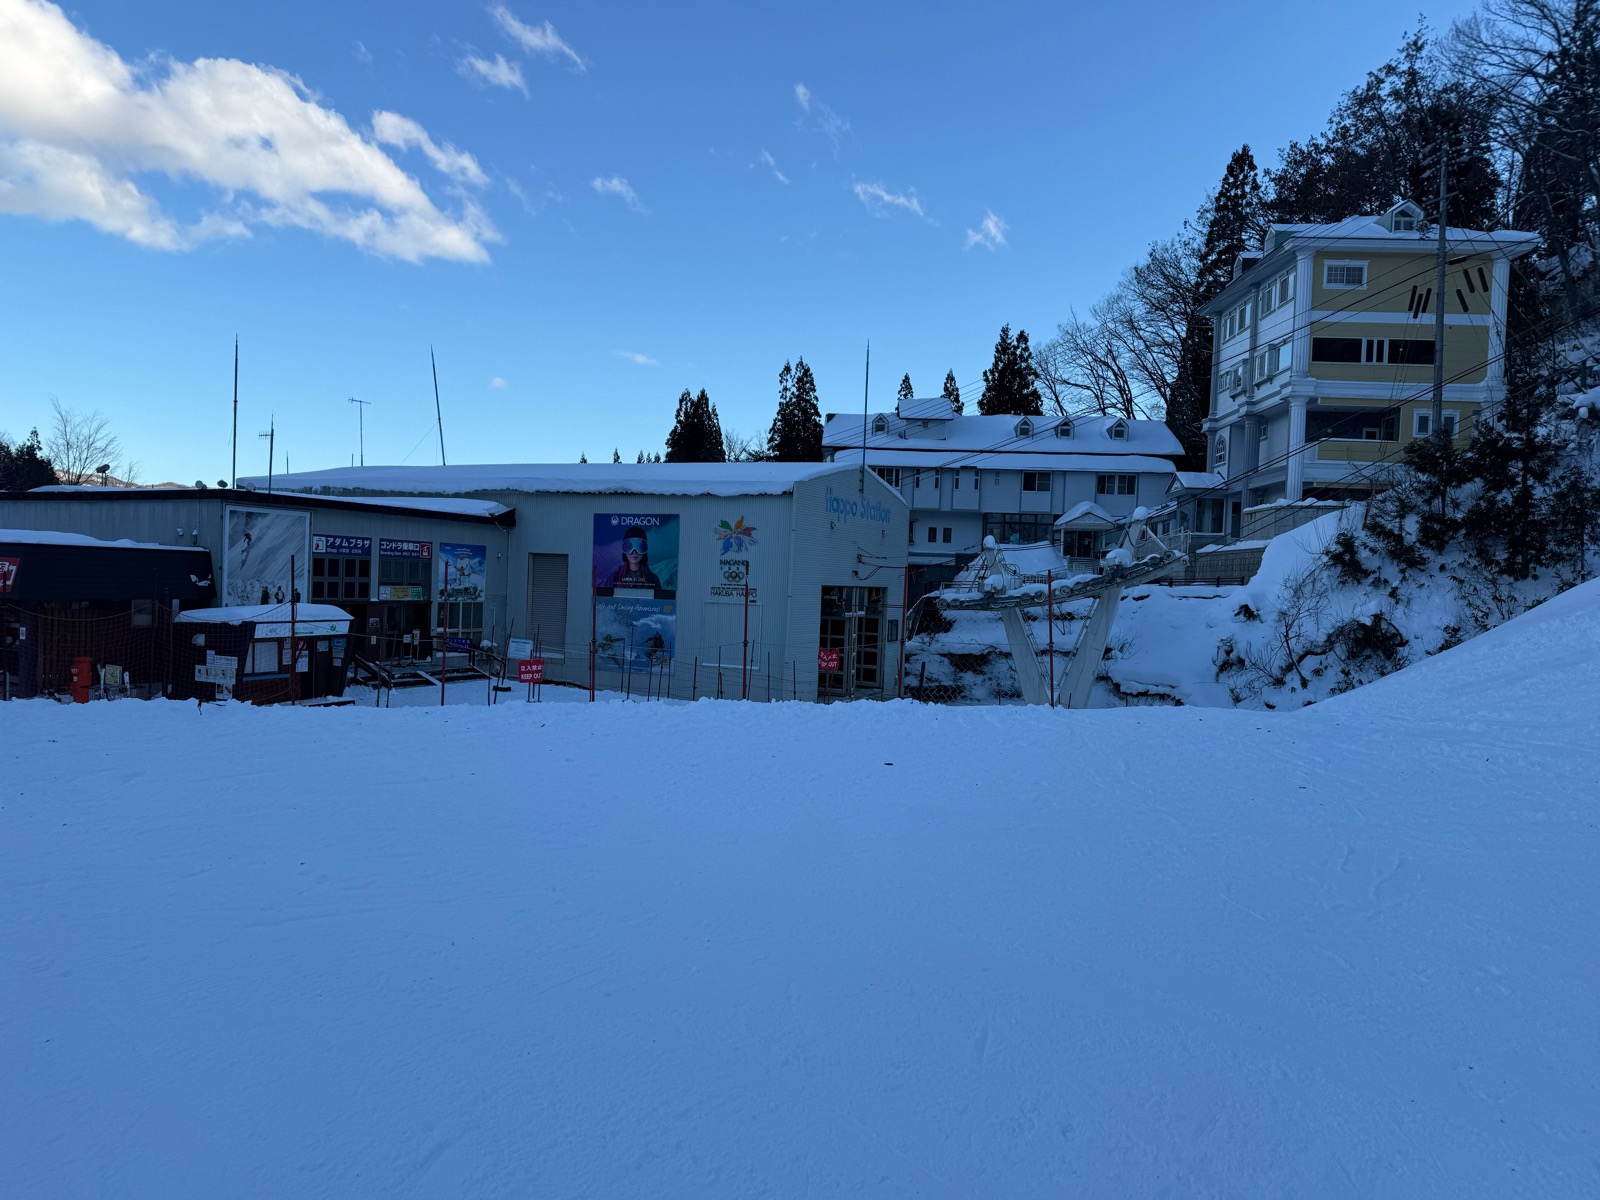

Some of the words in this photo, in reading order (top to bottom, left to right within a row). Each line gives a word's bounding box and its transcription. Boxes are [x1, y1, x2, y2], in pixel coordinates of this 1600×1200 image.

[826, 487, 858, 523] Happo
[861, 496, 891, 524] Station
[621, 516, 660, 526] DRAGON
